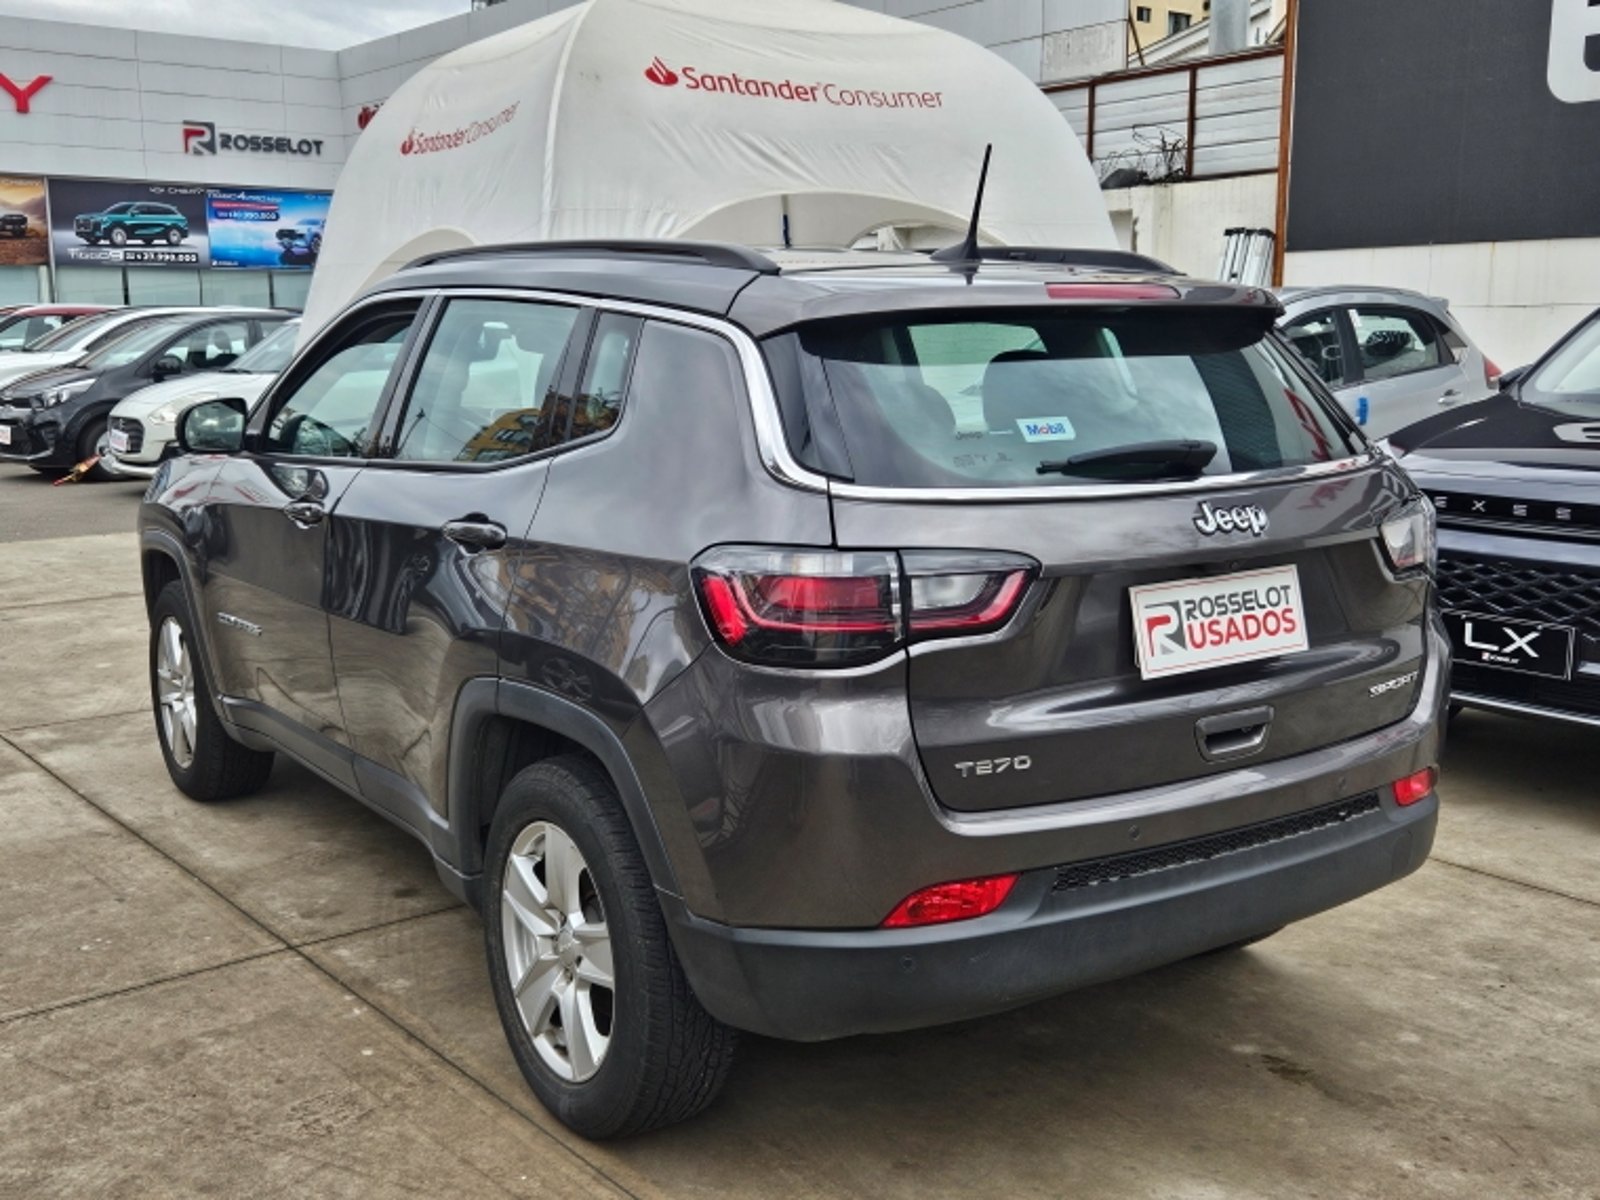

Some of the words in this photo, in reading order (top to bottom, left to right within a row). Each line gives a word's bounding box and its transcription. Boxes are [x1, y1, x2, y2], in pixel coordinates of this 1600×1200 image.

[682, 66, 817, 102] Santander
[823, 84, 944, 108] Consumer
[219, 133, 324, 156] ROSSELOT
[1025, 423, 1066, 435] Mobil
[1193, 501, 1269, 536] Jeep
[1185, 585, 1291, 621] ROSSELOT
[1188, 608, 1297, 650] USADOS
[1465, 622, 1540, 658] LX
[954, 755, 1032, 778] T270
